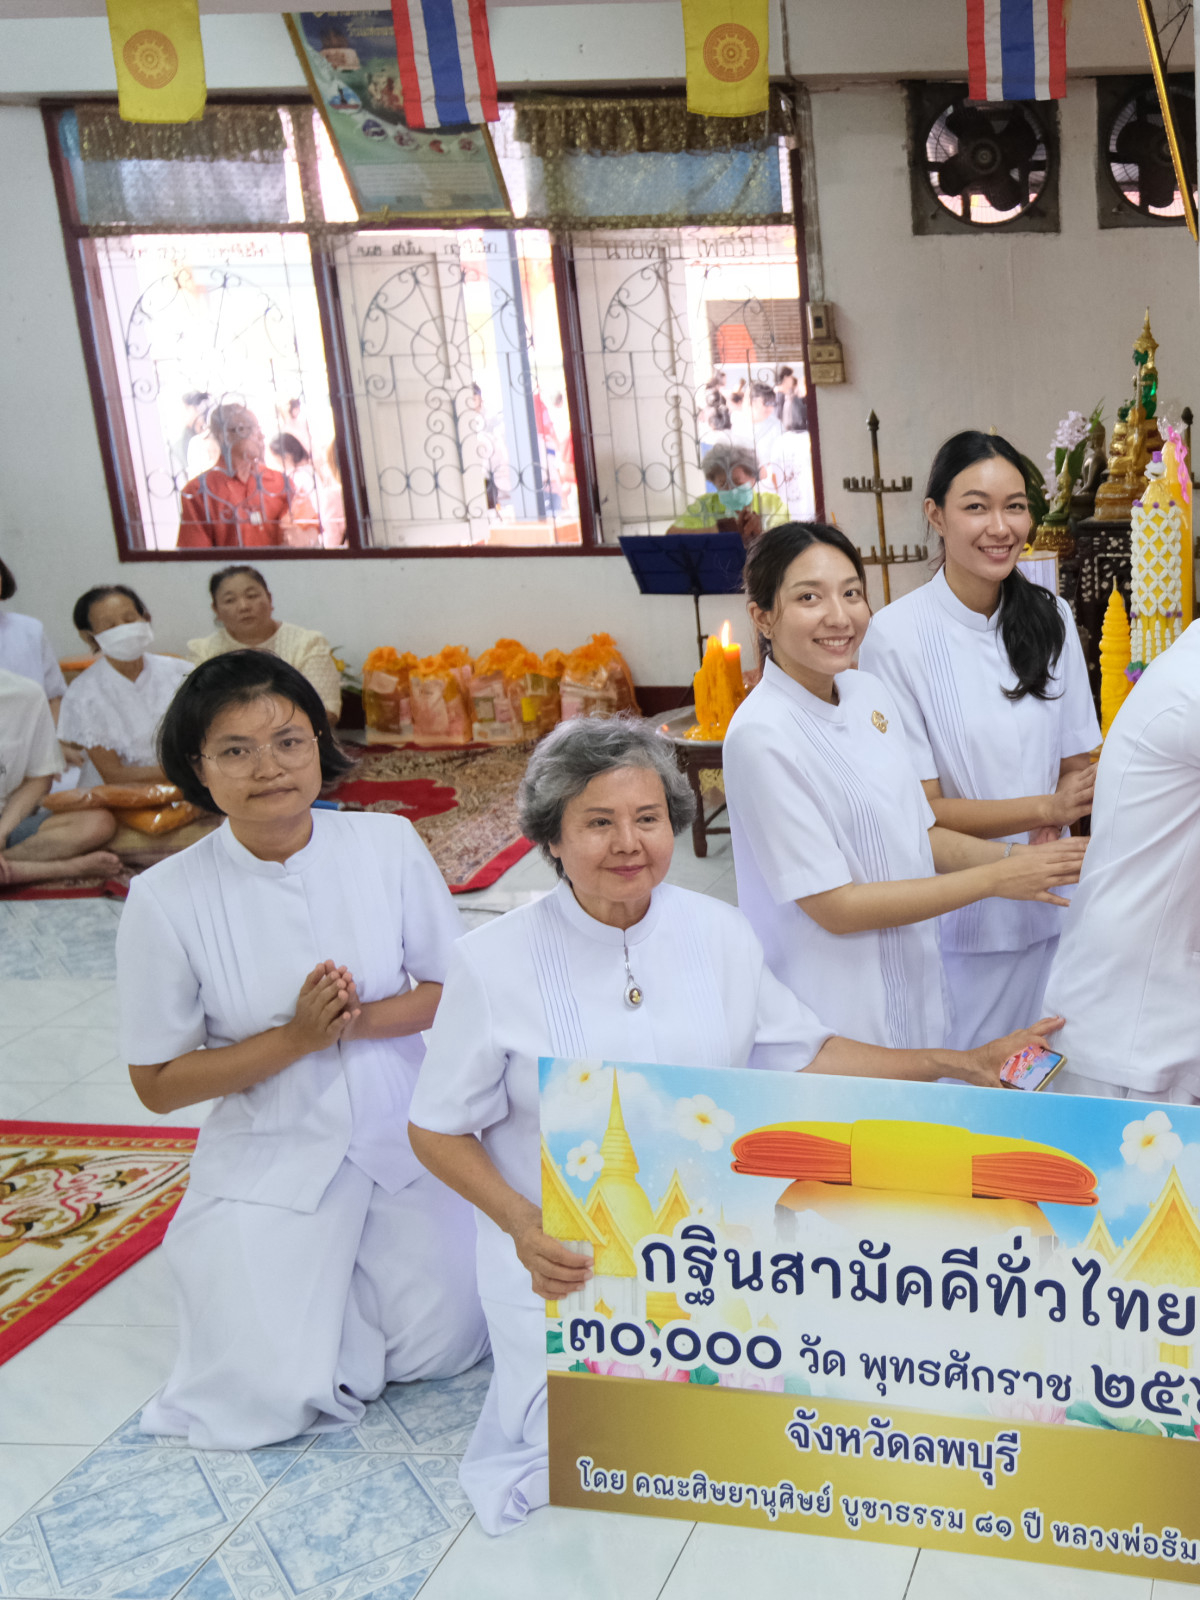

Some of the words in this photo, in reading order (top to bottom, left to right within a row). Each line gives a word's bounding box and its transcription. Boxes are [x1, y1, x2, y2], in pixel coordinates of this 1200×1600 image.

[641, 1224, 1196, 1337] กฐินสามัคคีทั่วไทย
[570, 1318, 782, 1374] ๓๐,๐๐๐
[799, 1333, 846, 1377] วัด
[859, 1349, 1072, 1402] พุทธศักราช
[788, 1409, 1018, 1486] จังหวัดลพบุรี
[579, 1460, 624, 1490] โดย
[636, 1473, 831, 1518] คณะศิษยานุศิษย์
[842, 1496, 964, 1530] บูชาธรรม
[975, 1515, 1012, 1537] ๘๑
[1023, 1511, 1041, 1539] ปี
